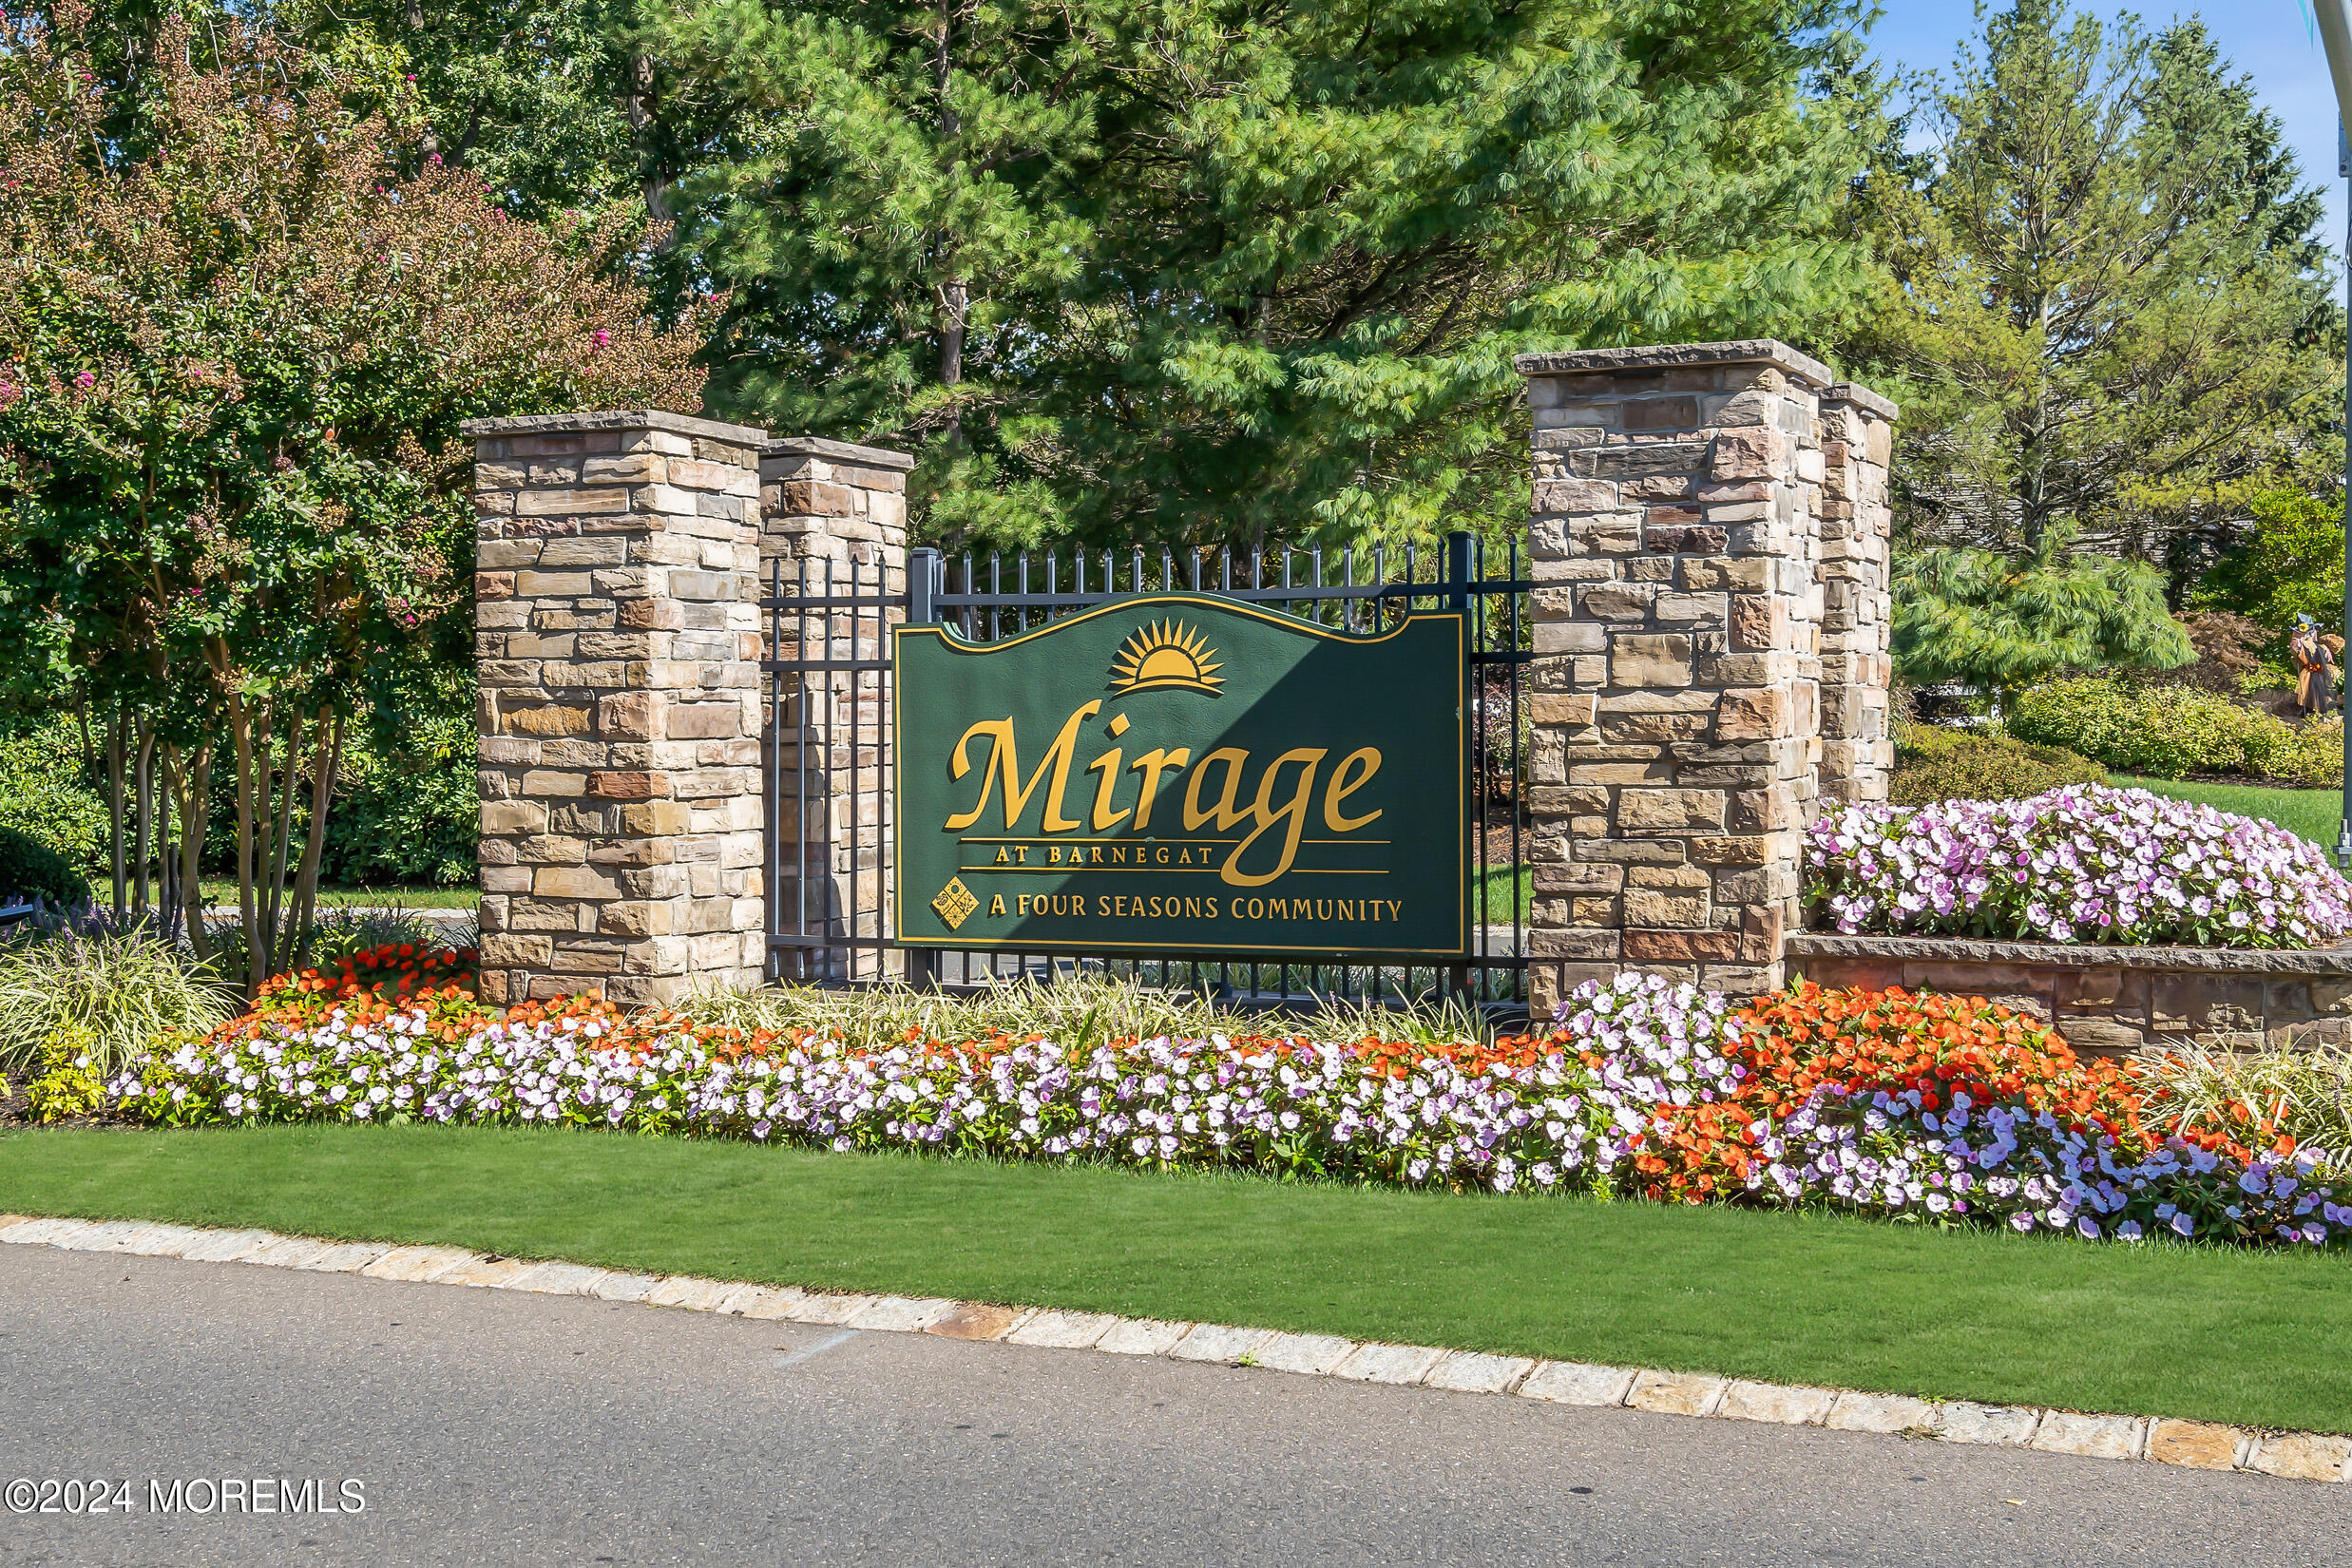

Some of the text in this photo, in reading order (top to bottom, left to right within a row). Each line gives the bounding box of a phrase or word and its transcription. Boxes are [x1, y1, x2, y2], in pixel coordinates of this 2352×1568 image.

[945, 698, 1383, 887] Mirage
[996, 845, 1214, 865] AT BARNEGAT
[990, 894, 1403, 922] A FOUR SEASONS COMMUNITY
